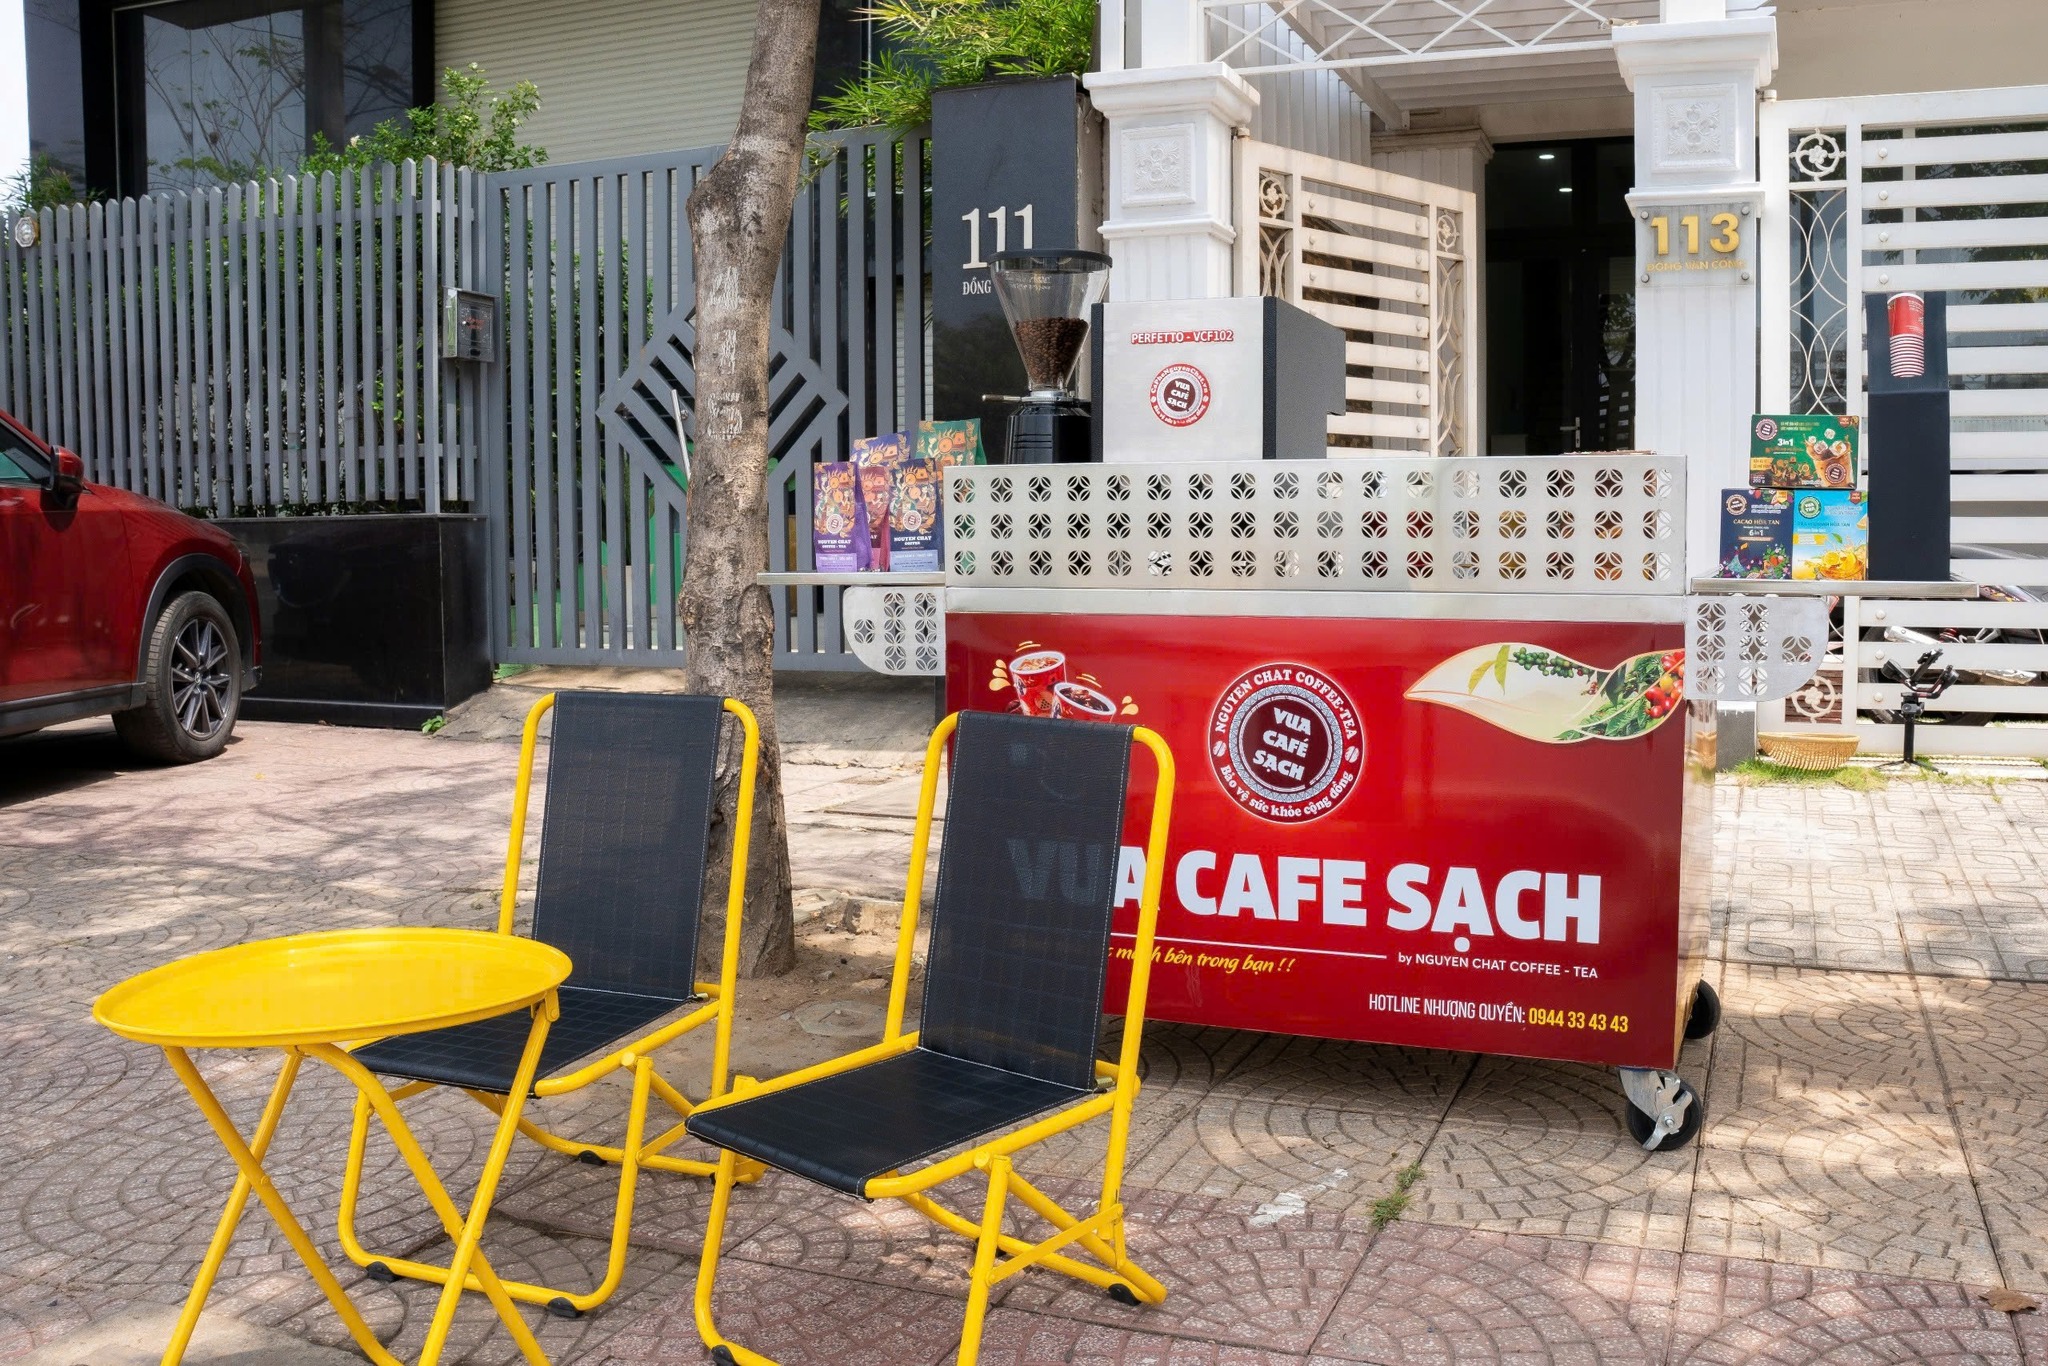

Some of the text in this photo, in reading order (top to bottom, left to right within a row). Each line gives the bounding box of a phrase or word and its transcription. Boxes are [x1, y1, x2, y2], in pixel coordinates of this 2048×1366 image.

[962, 204, 1033, 270] 111
[1650, 212, 1740, 255] 113
[1131, 331, 1185, 344] PERFETTO
[1193, 330, 1234, 342] VCF102
[1174, 380, 1191, 392] VUA
[1215, 669, 1358, 739] NGUYEN CHAT COFFEE-TEA
[1273, 707, 1312, 735] VUA
[1262, 728, 1309, 758] CAFÉ
[1252, 749, 1305, 781] SẠCH
[1236, 786, 1251, 802] vệ
[1270, 805, 1302, 817] khỏe
[1303, 797, 1332, 815] cộng
[1175, 849, 1367, 927] CAFE
[1386, 863, 1602, 953] SẠCH
[1163, 946, 1192, 965] bên
[1196, 953, 1239, 974] trong
[1242, 954, 1275, 976] bạn
[1398, 951, 1413, 965] by
[1415, 953, 1469, 968] NGUYEN
[1472, 958, 1507, 971] CHAT
[1509, 961, 1561, 976] COFFEE
[1573, 966, 1599, 979] TEA
[1368, 993, 1630, 1033] HOTLINE NHƯỢNG QUYỀN: 0944 33 43 43
